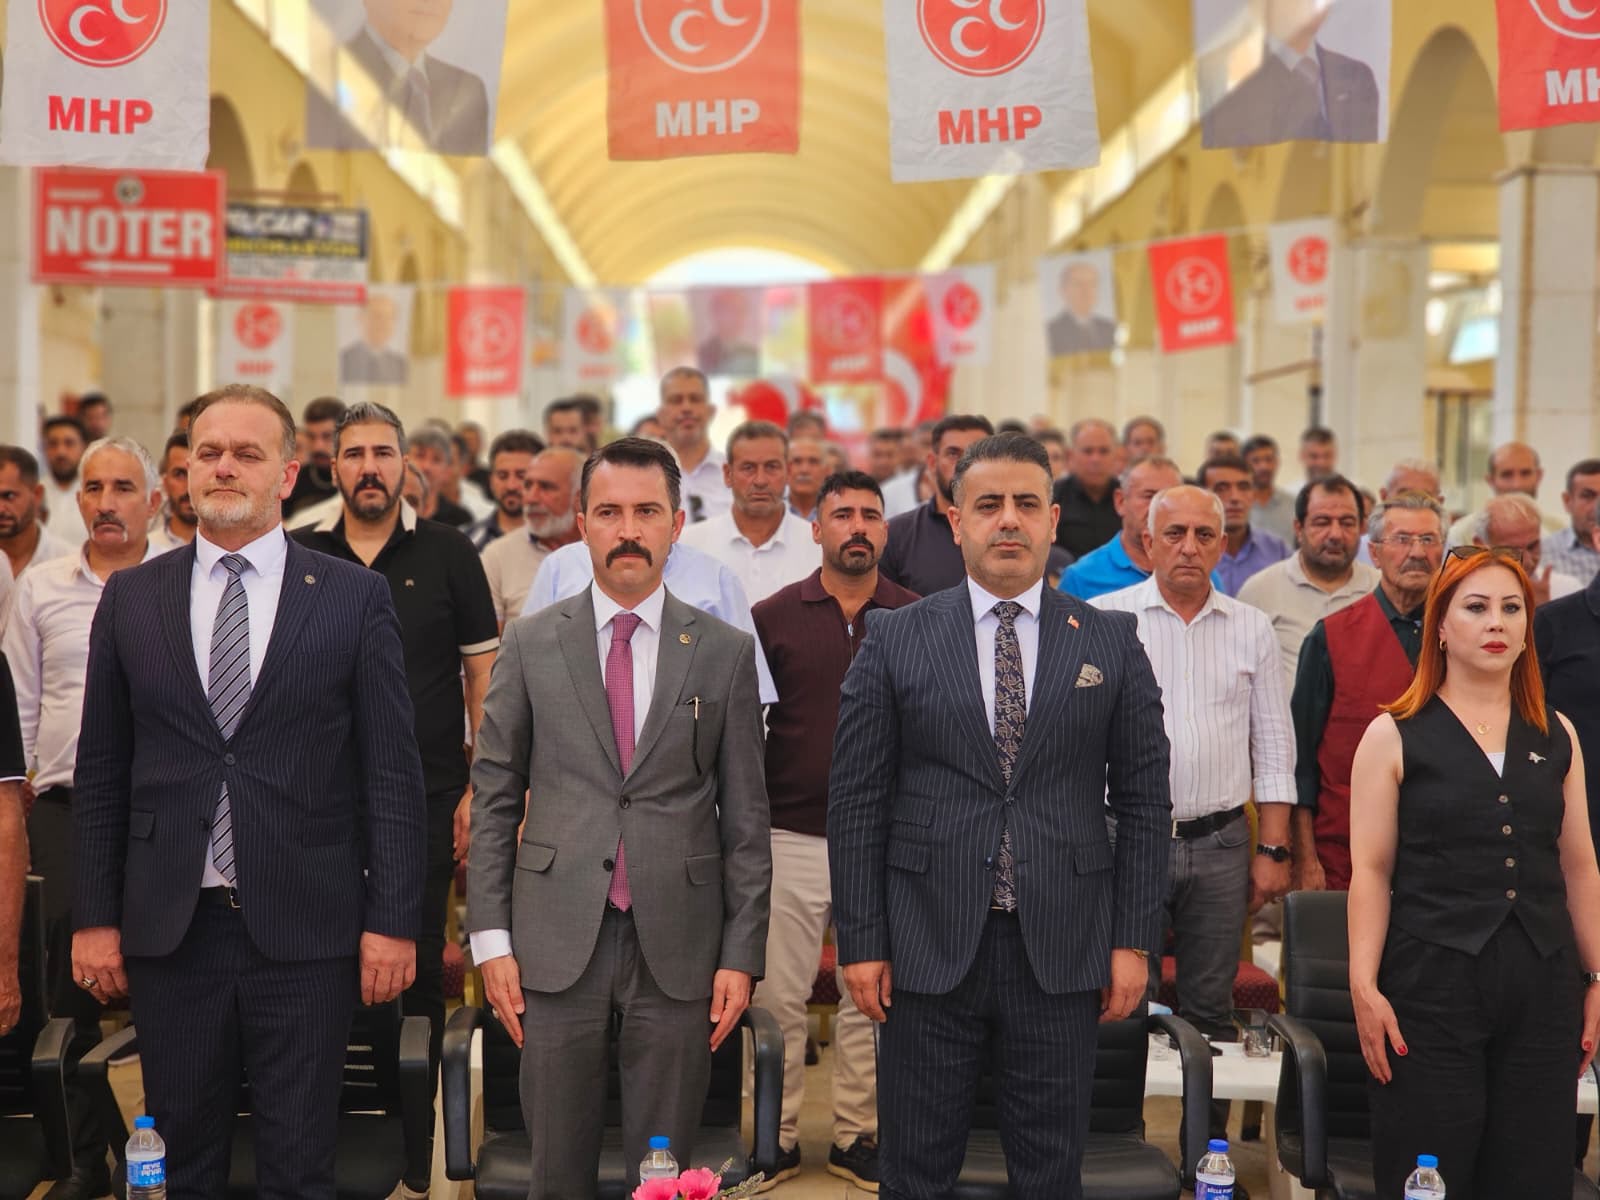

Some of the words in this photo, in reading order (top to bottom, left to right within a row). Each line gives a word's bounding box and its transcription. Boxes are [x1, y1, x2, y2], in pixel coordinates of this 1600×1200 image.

[48, 95, 154, 135] MHP
[655, 98, 761, 138] MHP
[938, 105, 1043, 145] MHP
[46, 206, 213, 257] NOTER
